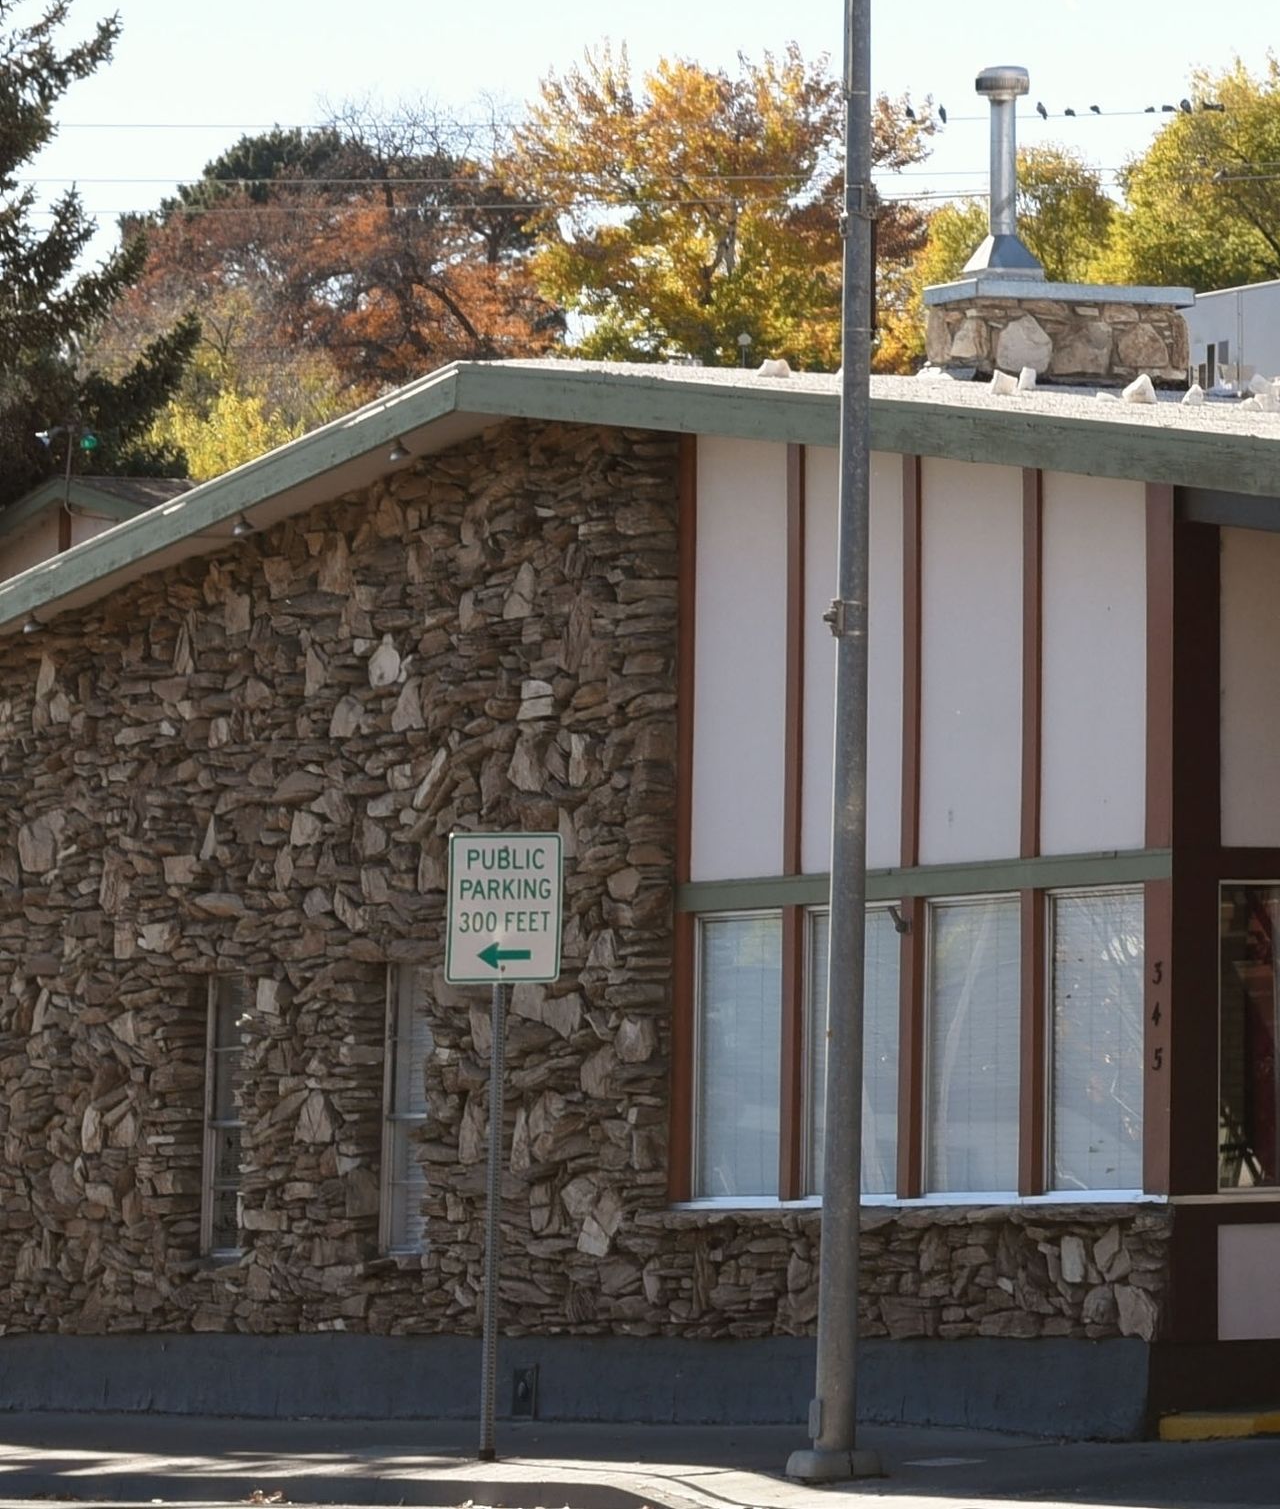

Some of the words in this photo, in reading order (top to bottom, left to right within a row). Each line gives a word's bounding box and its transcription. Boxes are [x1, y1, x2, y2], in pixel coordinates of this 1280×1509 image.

[467, 848, 545, 870] PUBLIC
[459, 878, 552, 900] PARKING
[458, 911, 498, 933] 300
[505, 911, 551, 932] FEET
